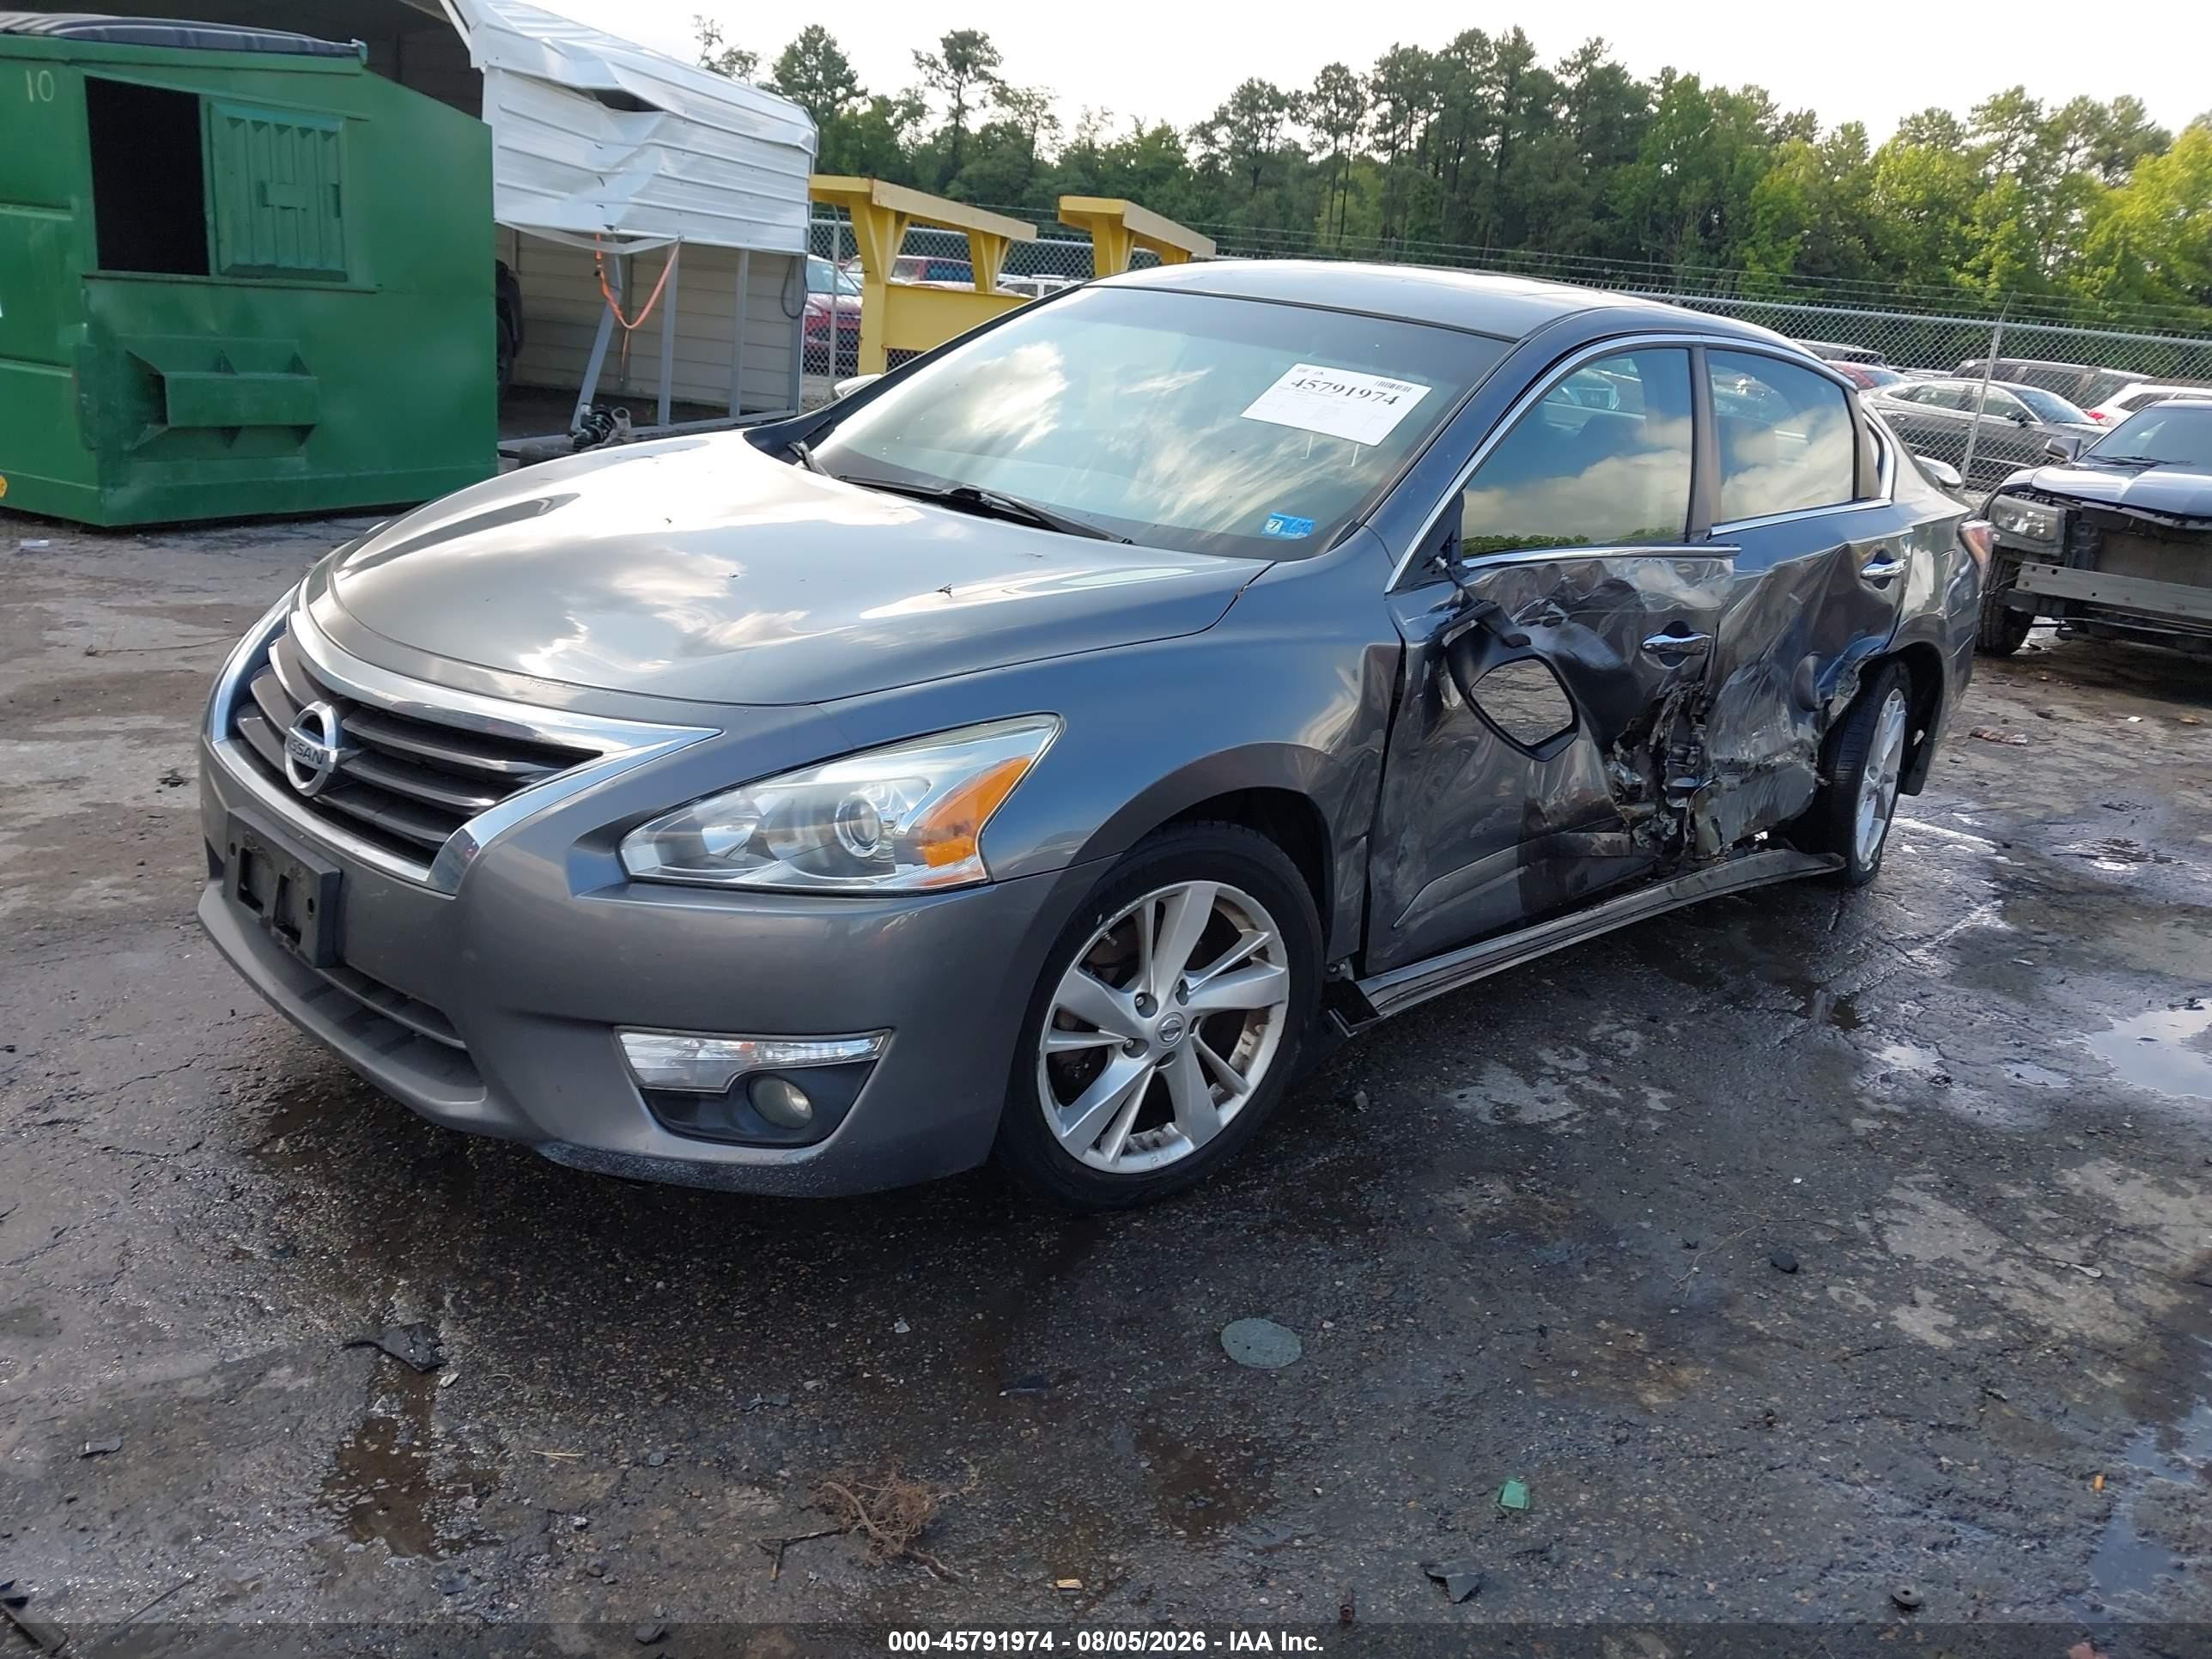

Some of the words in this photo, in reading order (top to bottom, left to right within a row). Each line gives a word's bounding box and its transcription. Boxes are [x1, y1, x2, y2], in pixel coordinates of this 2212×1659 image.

[26, 70, 55, 102] 10
[1291, 378, 1401, 405] 45791974
[289, 738, 325, 765] SSAN
